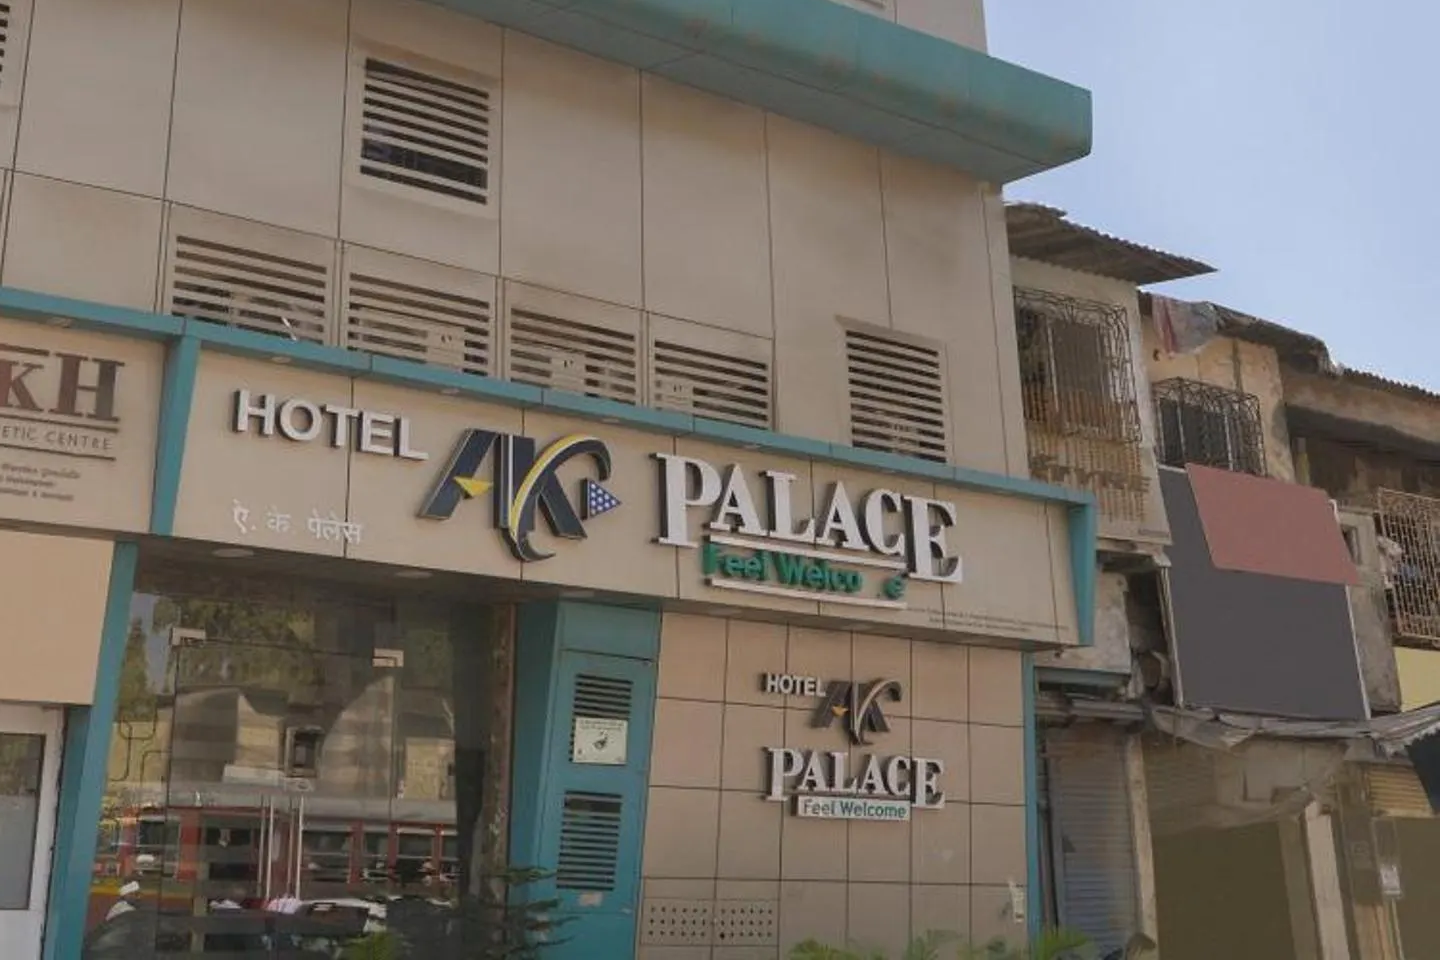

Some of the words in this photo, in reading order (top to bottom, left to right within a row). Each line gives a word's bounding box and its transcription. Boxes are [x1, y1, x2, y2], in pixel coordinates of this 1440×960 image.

[44, 430, 113, 450] CENTRE
[234, 388, 429, 460] HOTEL
[650, 452, 962, 583] PALACE
[701, 542, 770, 580] Feel
[773, 551, 906, 600] Welcoe
[764, 672, 827, 697] HOTEL
[762, 746, 946, 809] PALACE
[803, 798, 835, 815] Feel
[839, 801, 907, 818] Welcome
